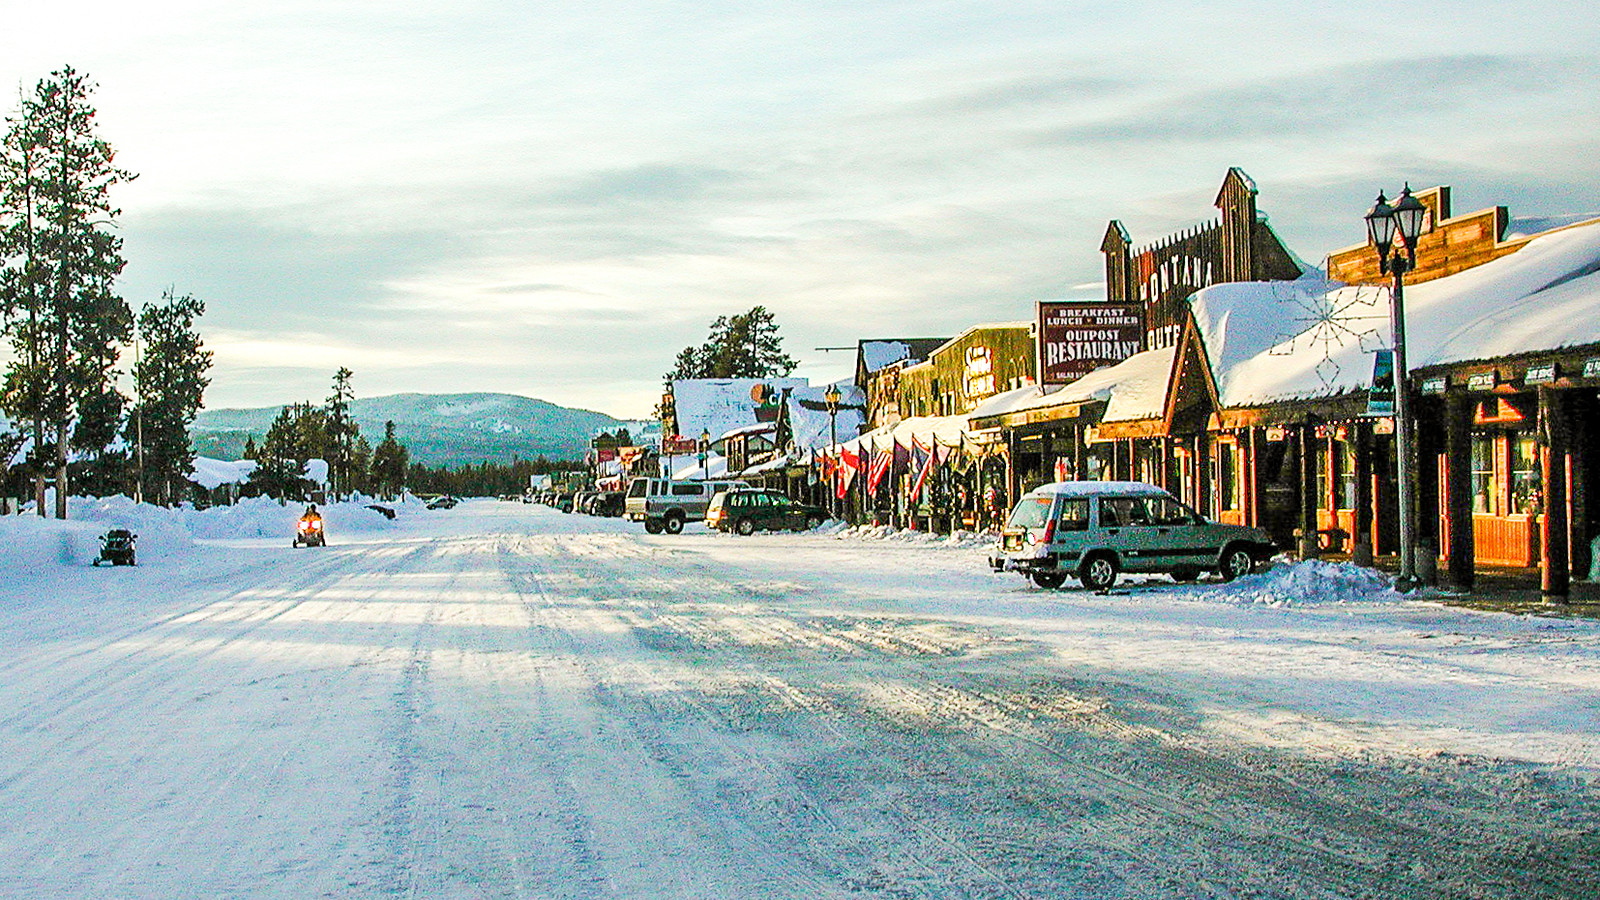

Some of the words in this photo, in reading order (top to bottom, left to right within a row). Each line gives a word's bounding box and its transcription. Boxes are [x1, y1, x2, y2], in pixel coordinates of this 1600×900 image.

[1139, 254, 1213, 310] MONTANA
[1059, 308, 1126, 317] BREAKFAST
[1046, 317, 1083, 325] LUNCH
[1095, 316, 1139, 325] DINNER
[1065, 329, 1121, 341] OUTPOST
[1046, 341, 1141, 367] RESTAURANT
